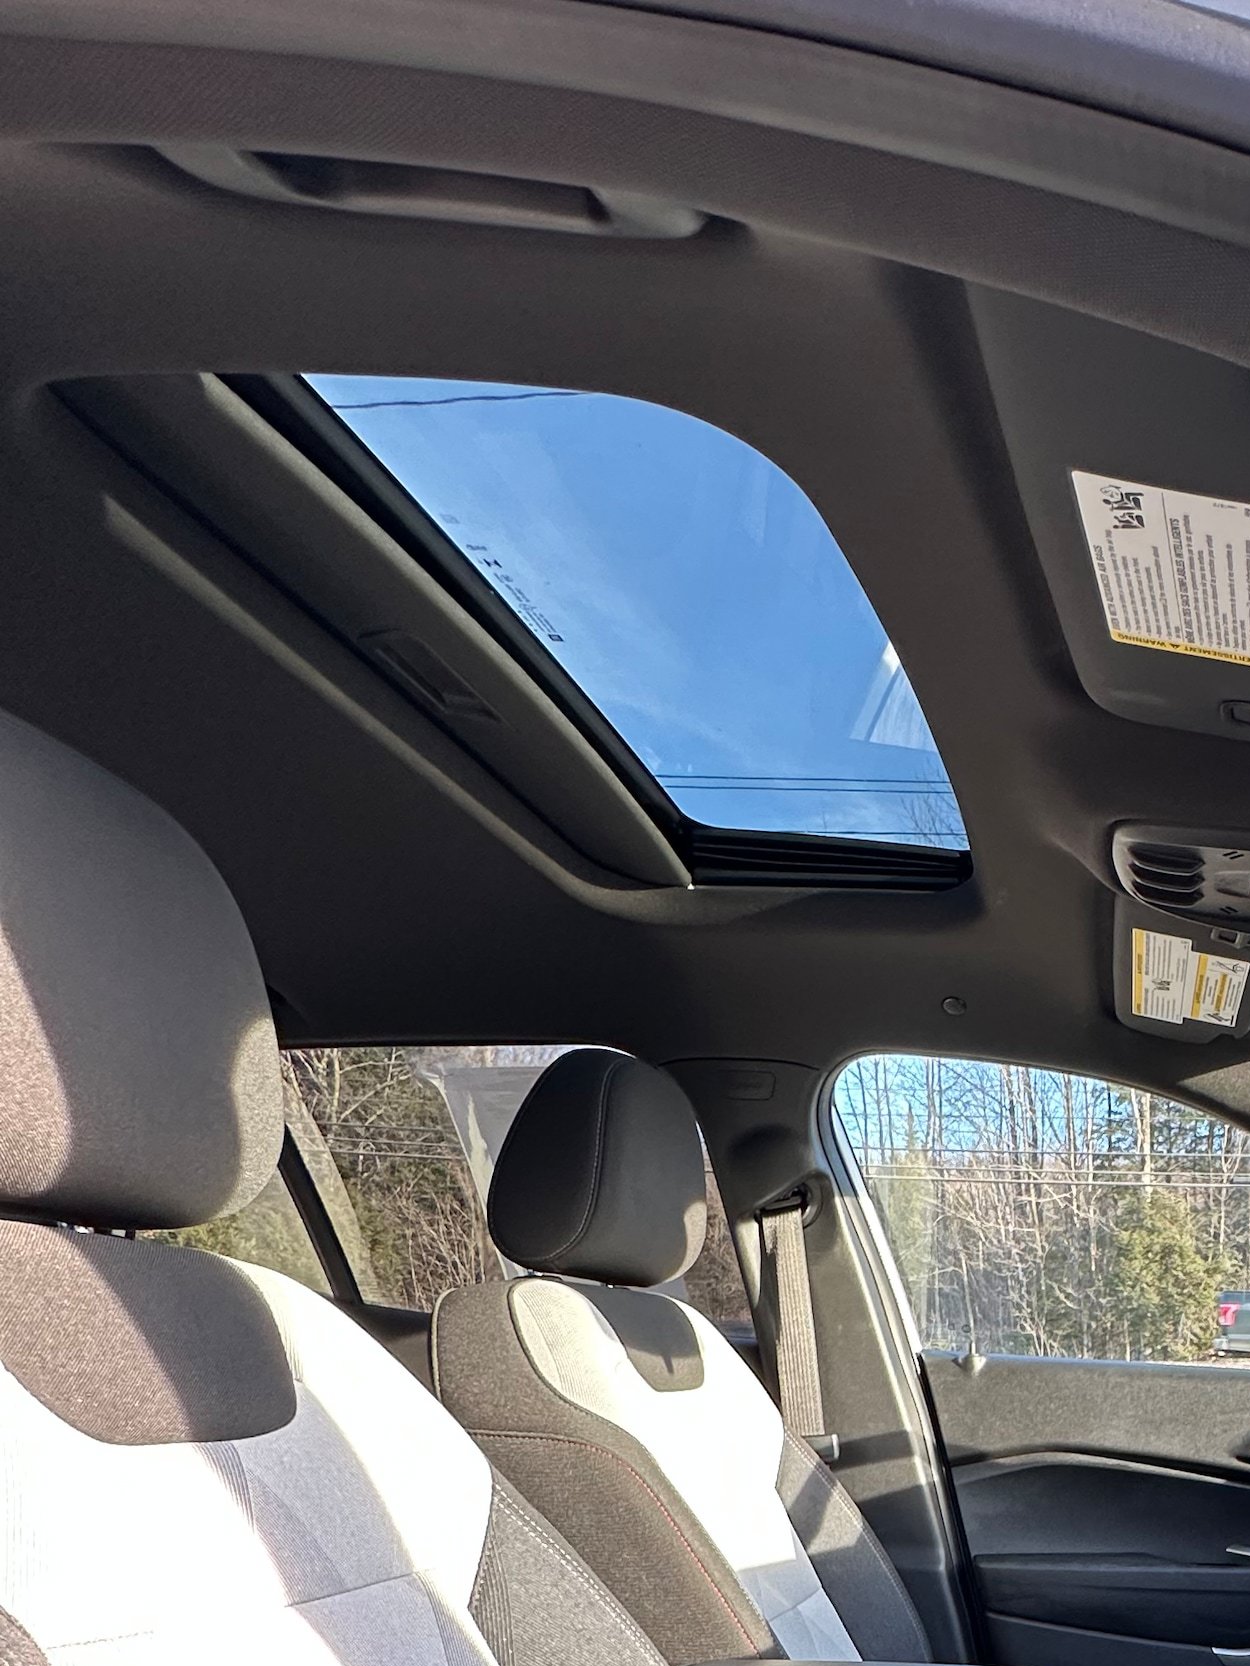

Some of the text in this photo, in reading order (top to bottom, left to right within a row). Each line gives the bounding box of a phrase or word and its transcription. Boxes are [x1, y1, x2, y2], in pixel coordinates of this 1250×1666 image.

[1169, 518, 1183, 558] INTELLIGENTS
[1092, 544, 1104, 561] BAGS
[1097, 562, 1107, 572] AIR
[1180, 593, 1189, 607] SACS
[1117, 633, 1168, 647] WARNING
